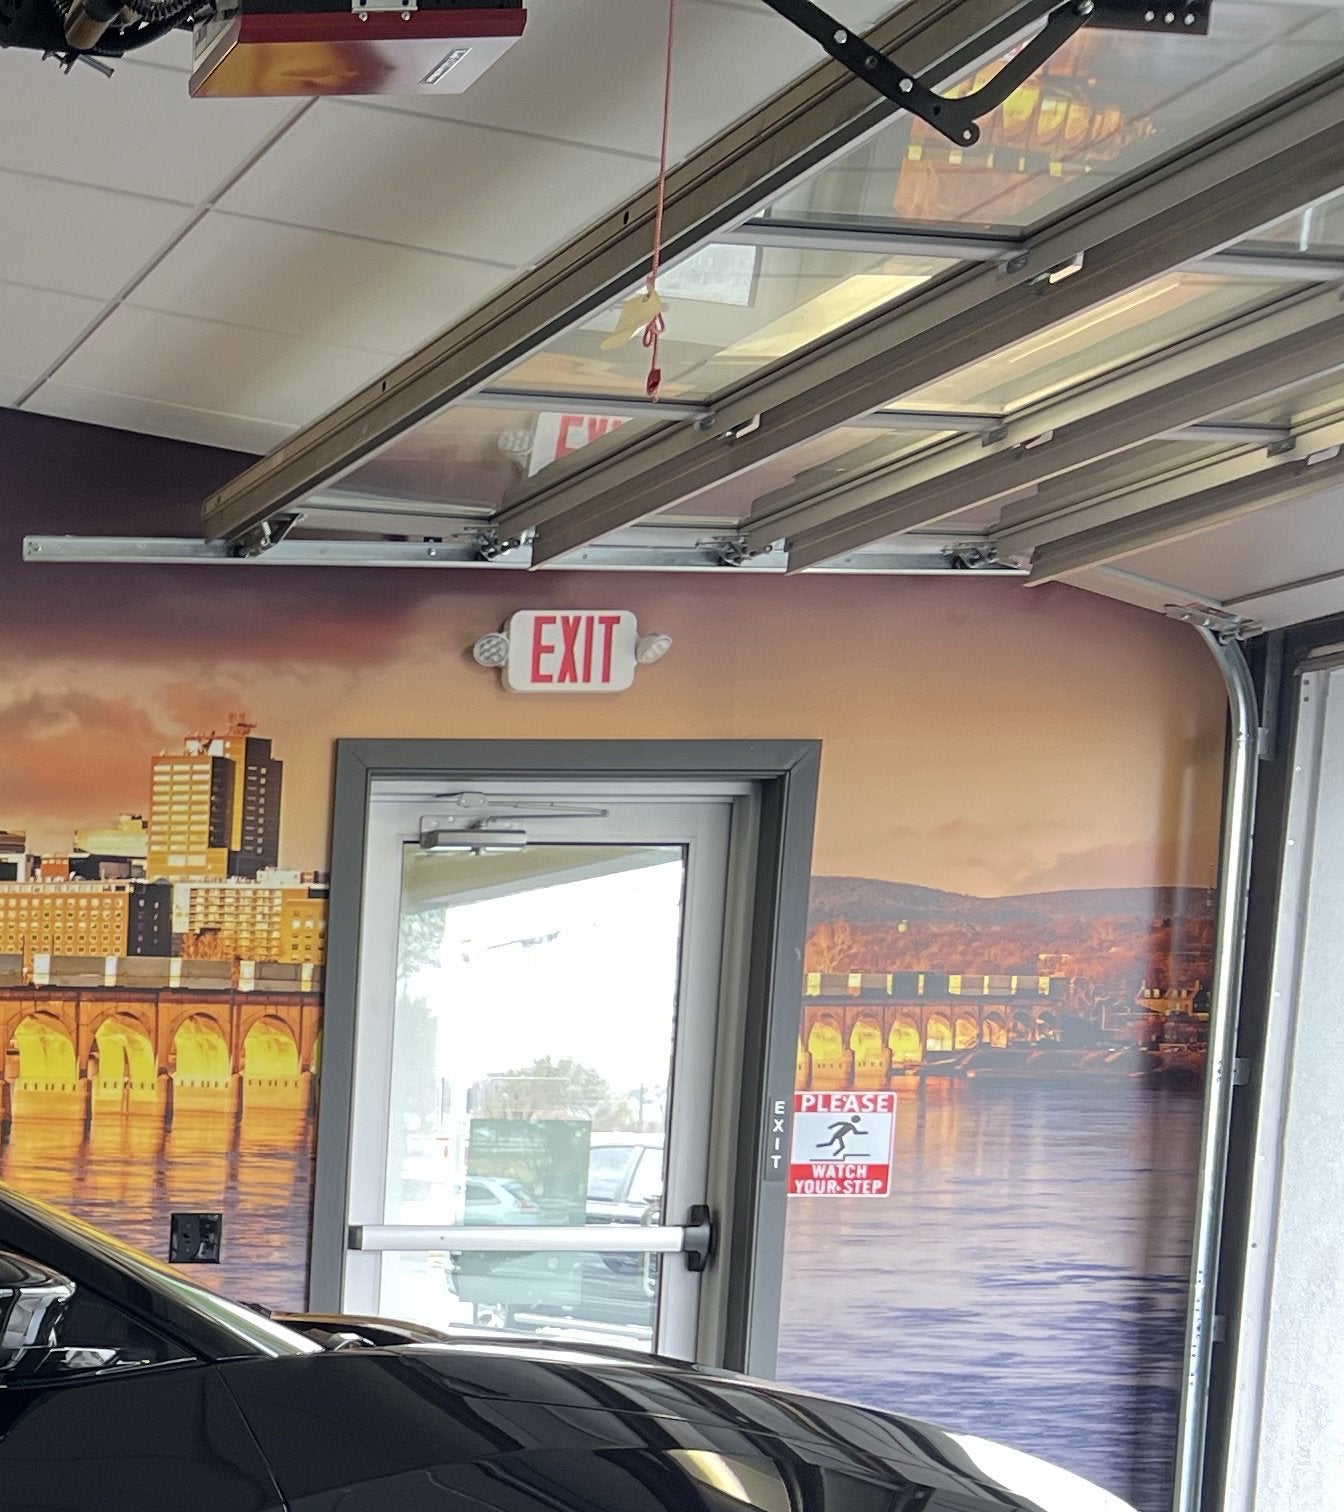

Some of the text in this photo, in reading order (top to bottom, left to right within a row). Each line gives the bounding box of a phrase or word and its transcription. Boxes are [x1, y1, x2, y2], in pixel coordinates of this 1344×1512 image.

[530, 615, 621, 683] EXIT
[800, 1094, 889, 1113] PLEASE
[770, 1100, 786, 1169] EXIT
[812, 1164, 868, 1179] WATCH
[794, 1179, 883, 1194] YOUR STEP
